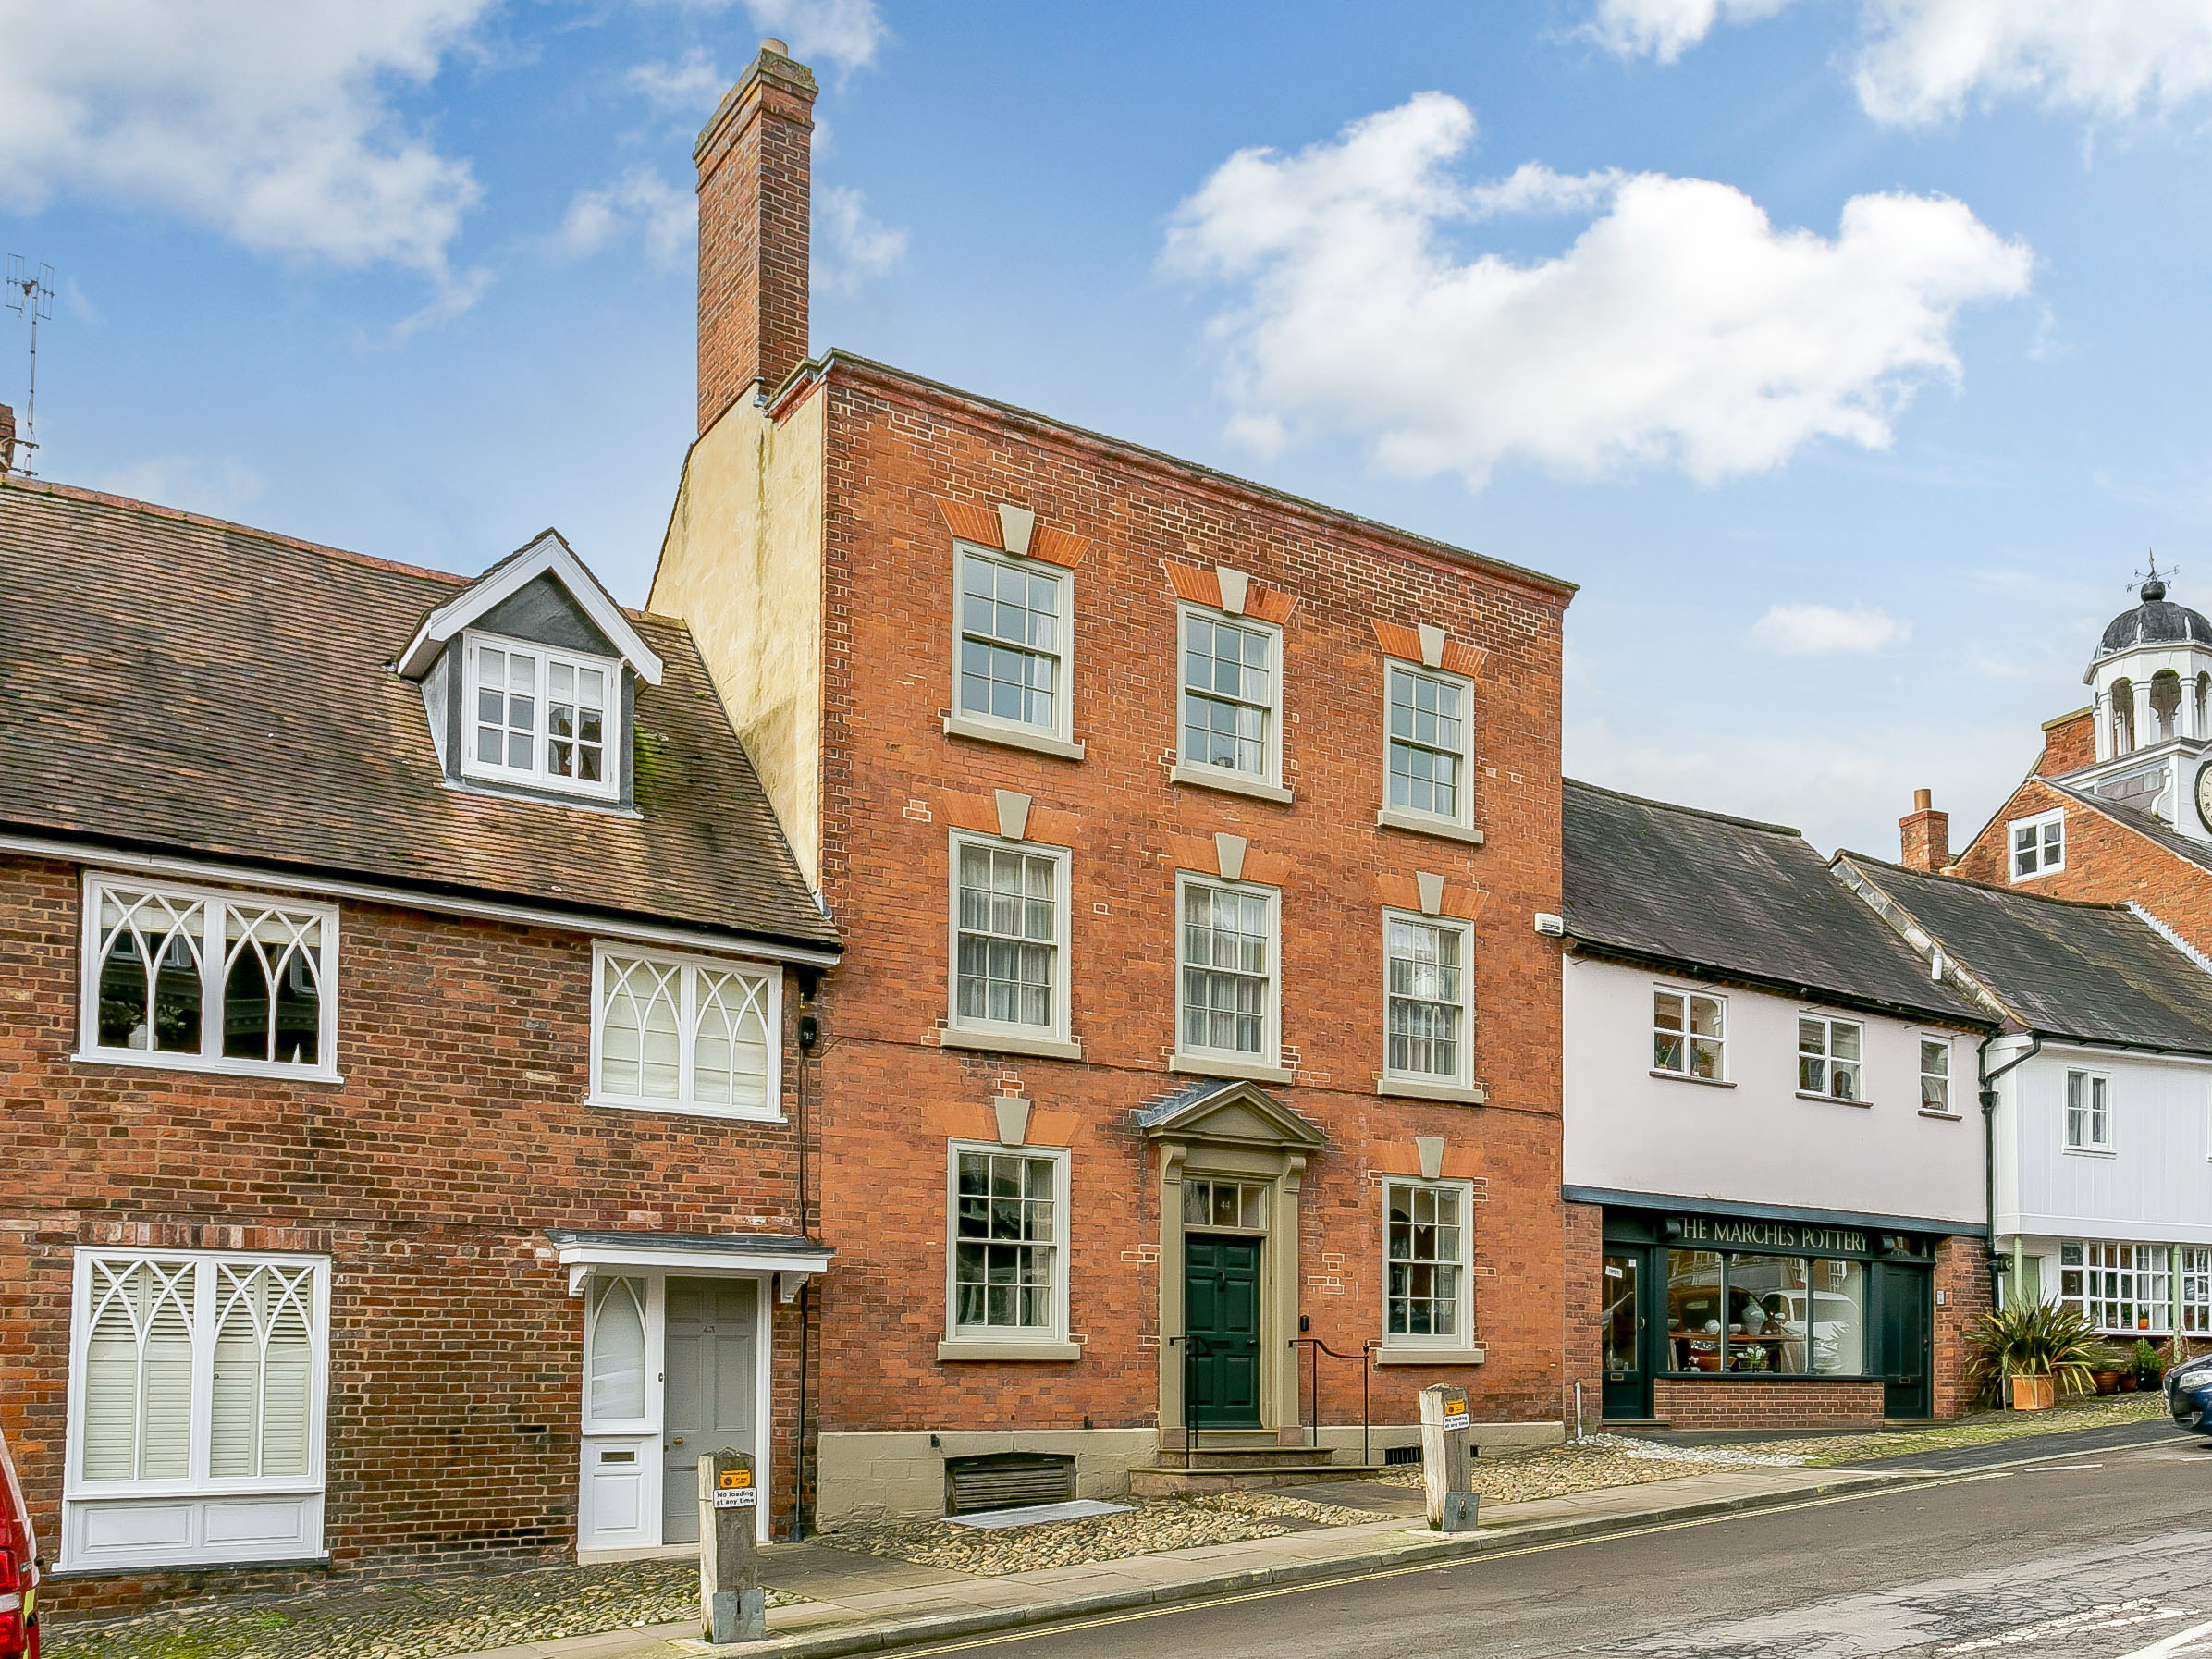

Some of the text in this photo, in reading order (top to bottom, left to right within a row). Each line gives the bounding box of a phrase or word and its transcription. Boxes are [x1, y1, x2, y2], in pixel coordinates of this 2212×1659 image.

[1220, 1200, 1230, 1210] 44
[1678, 1217, 1868, 1252] HE MARCHES POTTERY
[703, 1325, 716, 1334] 43
